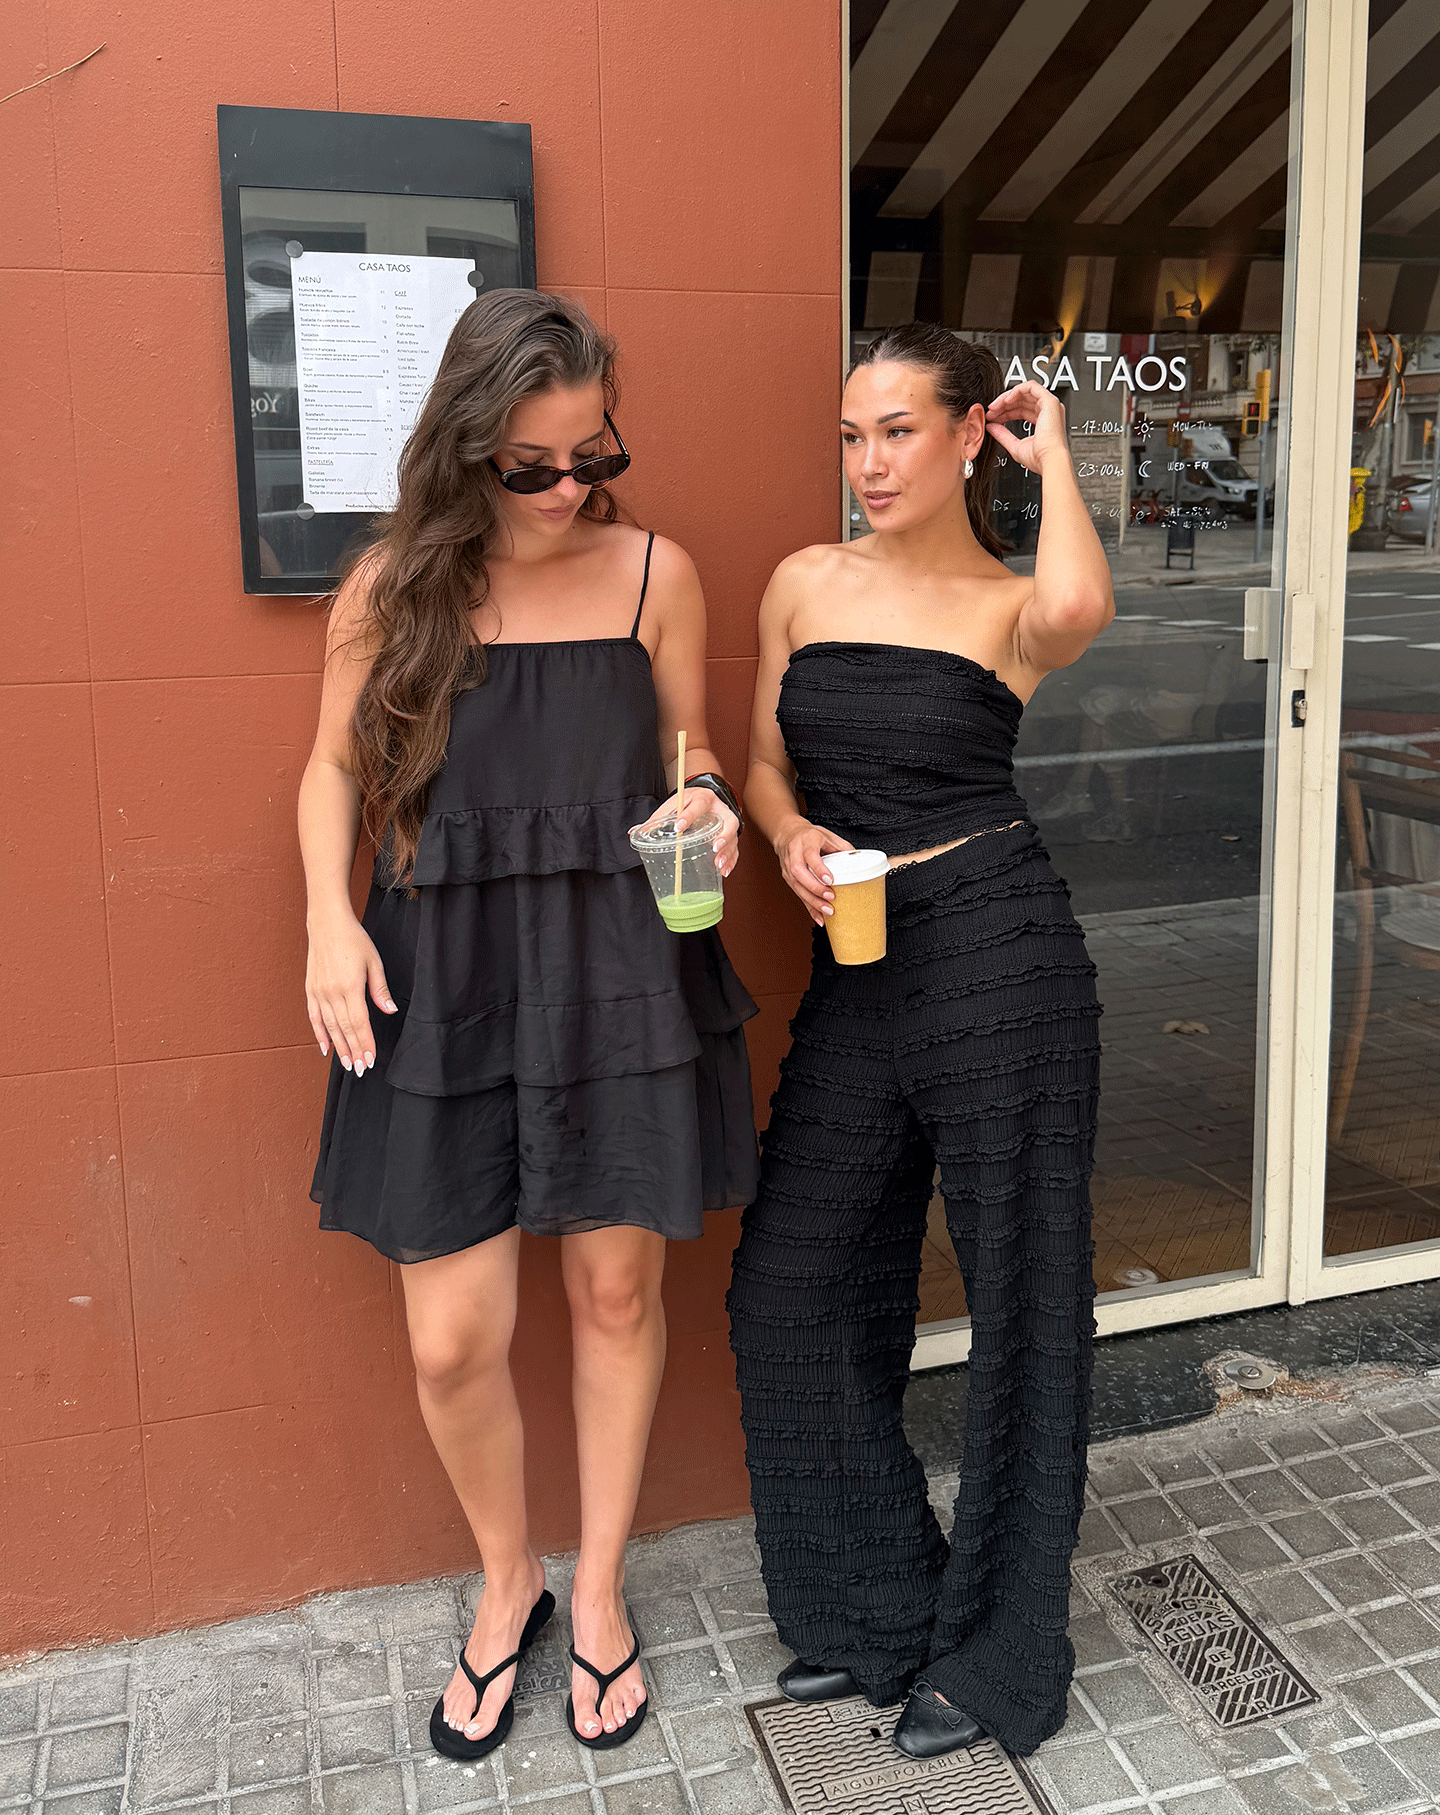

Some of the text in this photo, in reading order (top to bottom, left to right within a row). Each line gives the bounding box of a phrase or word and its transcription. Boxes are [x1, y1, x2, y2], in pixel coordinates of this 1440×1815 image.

[358, 262, 411, 273] CASA TAOS
[298, 275, 322, 284] MENÚ
[998, 355, 1187, 392] ASA TAOS
[1177, 1612, 1200, 1626] DE
[1162, 1611, 1236, 1647] AGUAS
[1208, 1649, 1232, 1664] DE
[1199, 1664, 1281, 1696] BARCELONA
[1254, 1699, 1270, 1713] R
[832, 1753, 966, 1796] AIGUA POTABLE
